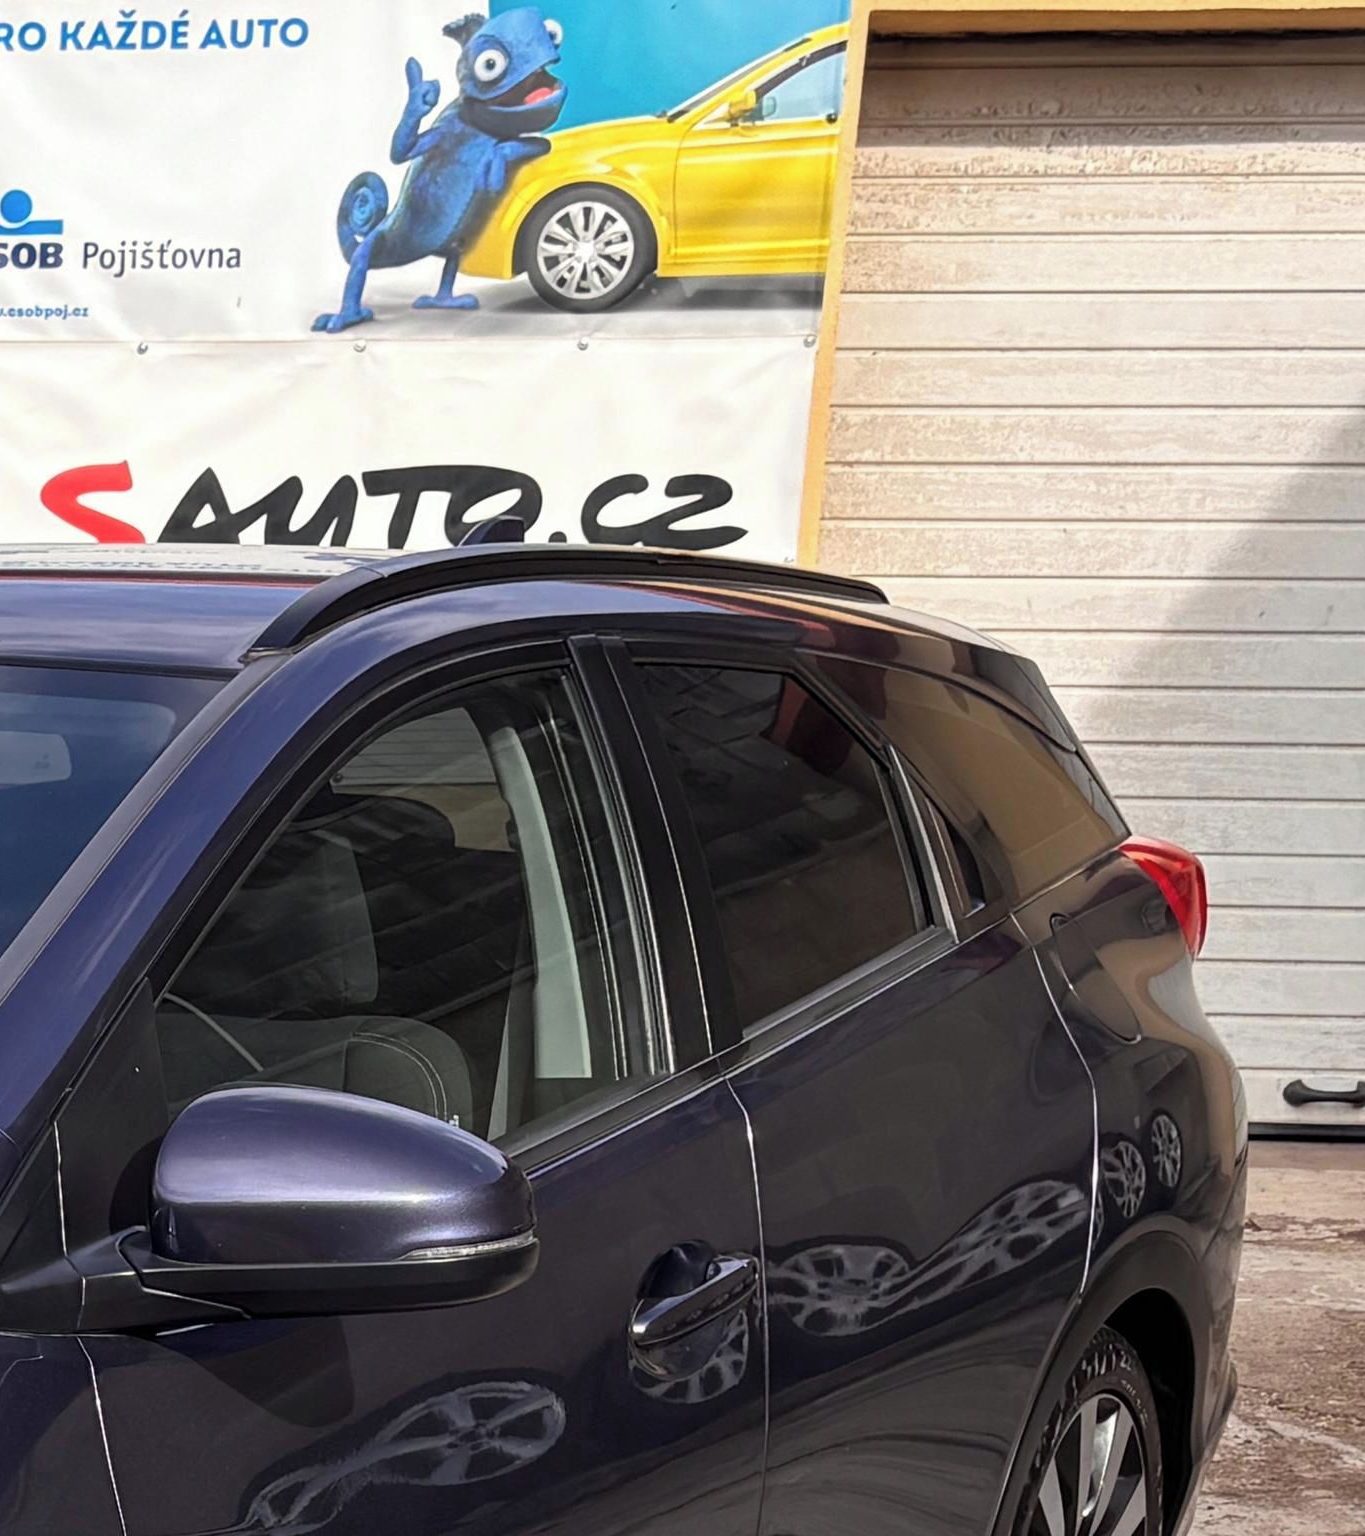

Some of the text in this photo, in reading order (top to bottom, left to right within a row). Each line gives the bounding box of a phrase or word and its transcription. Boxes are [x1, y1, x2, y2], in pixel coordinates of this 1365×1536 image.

[60, 9, 190, 50] KAŽDÉ
[199, 17, 310, 49] AUTO
[82, 239, 242, 278] Pojišťovna
